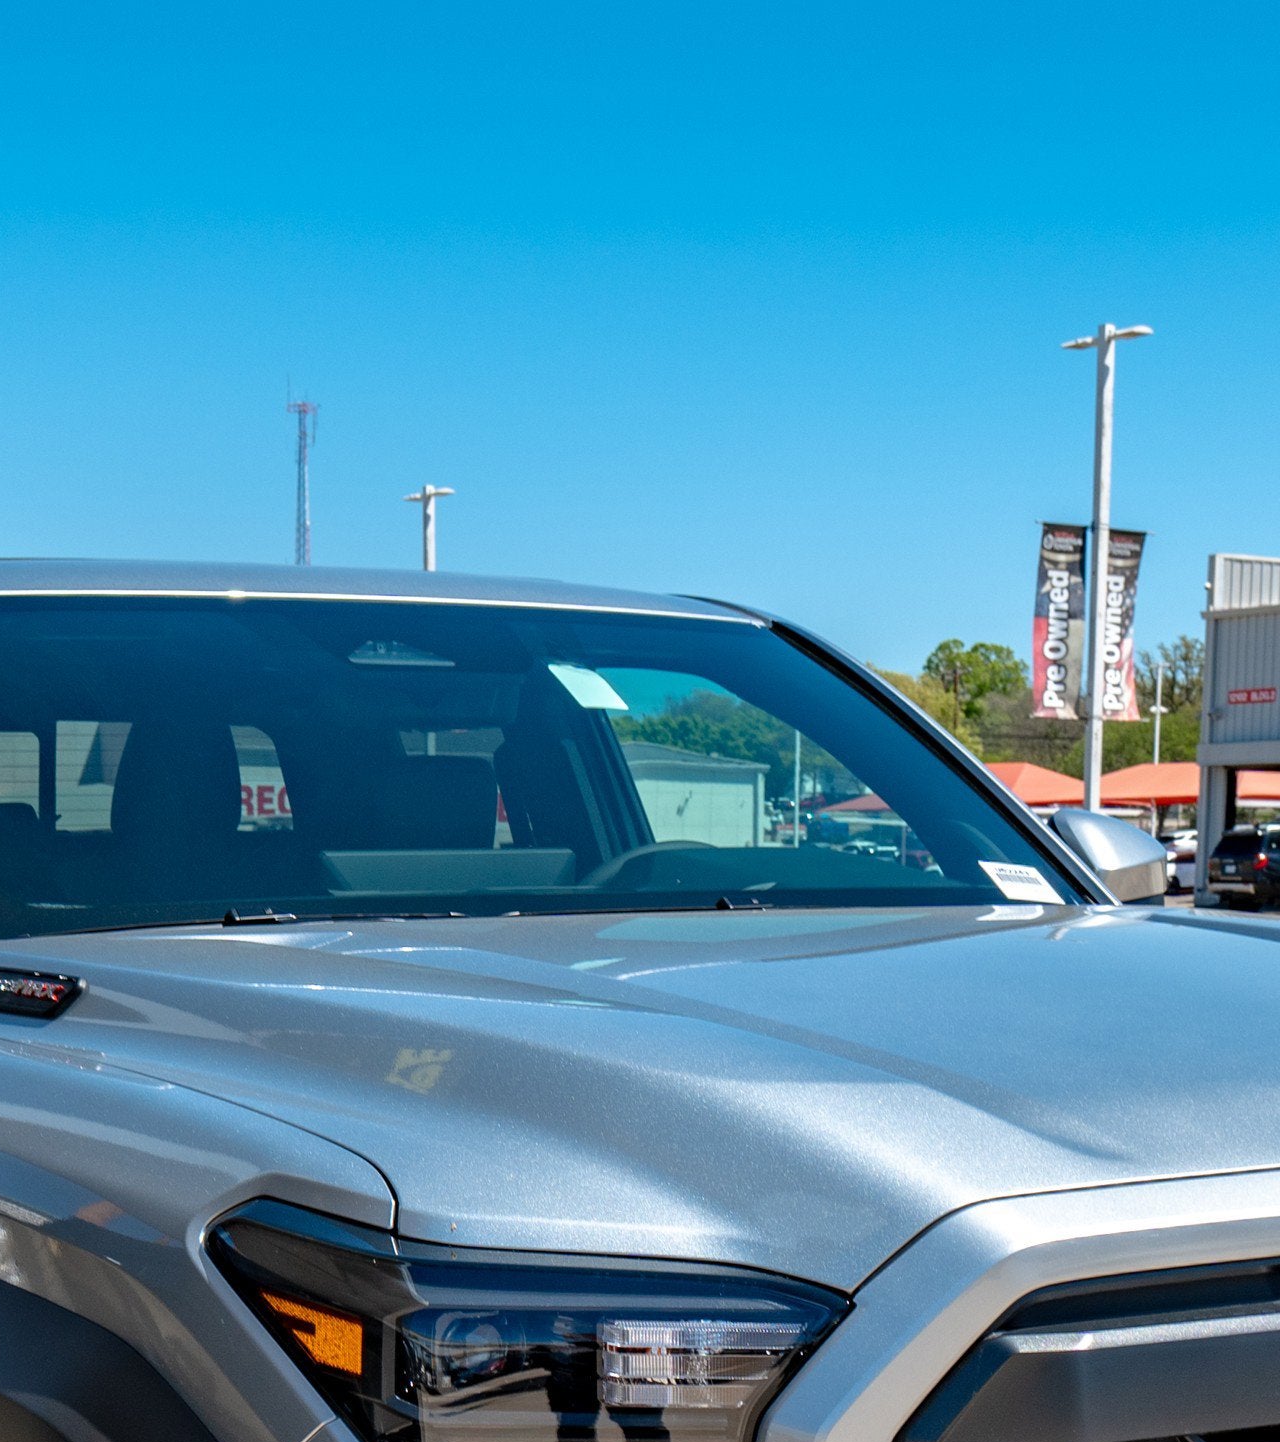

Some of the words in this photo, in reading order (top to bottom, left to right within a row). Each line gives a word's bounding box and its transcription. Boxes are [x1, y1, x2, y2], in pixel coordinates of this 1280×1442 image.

[1043, 570, 1069, 660] Owned
[1104, 575, 1125, 664] Owned
[1043, 664, 1067, 708] Pre
[1103, 668, 1125, 710] Pre
